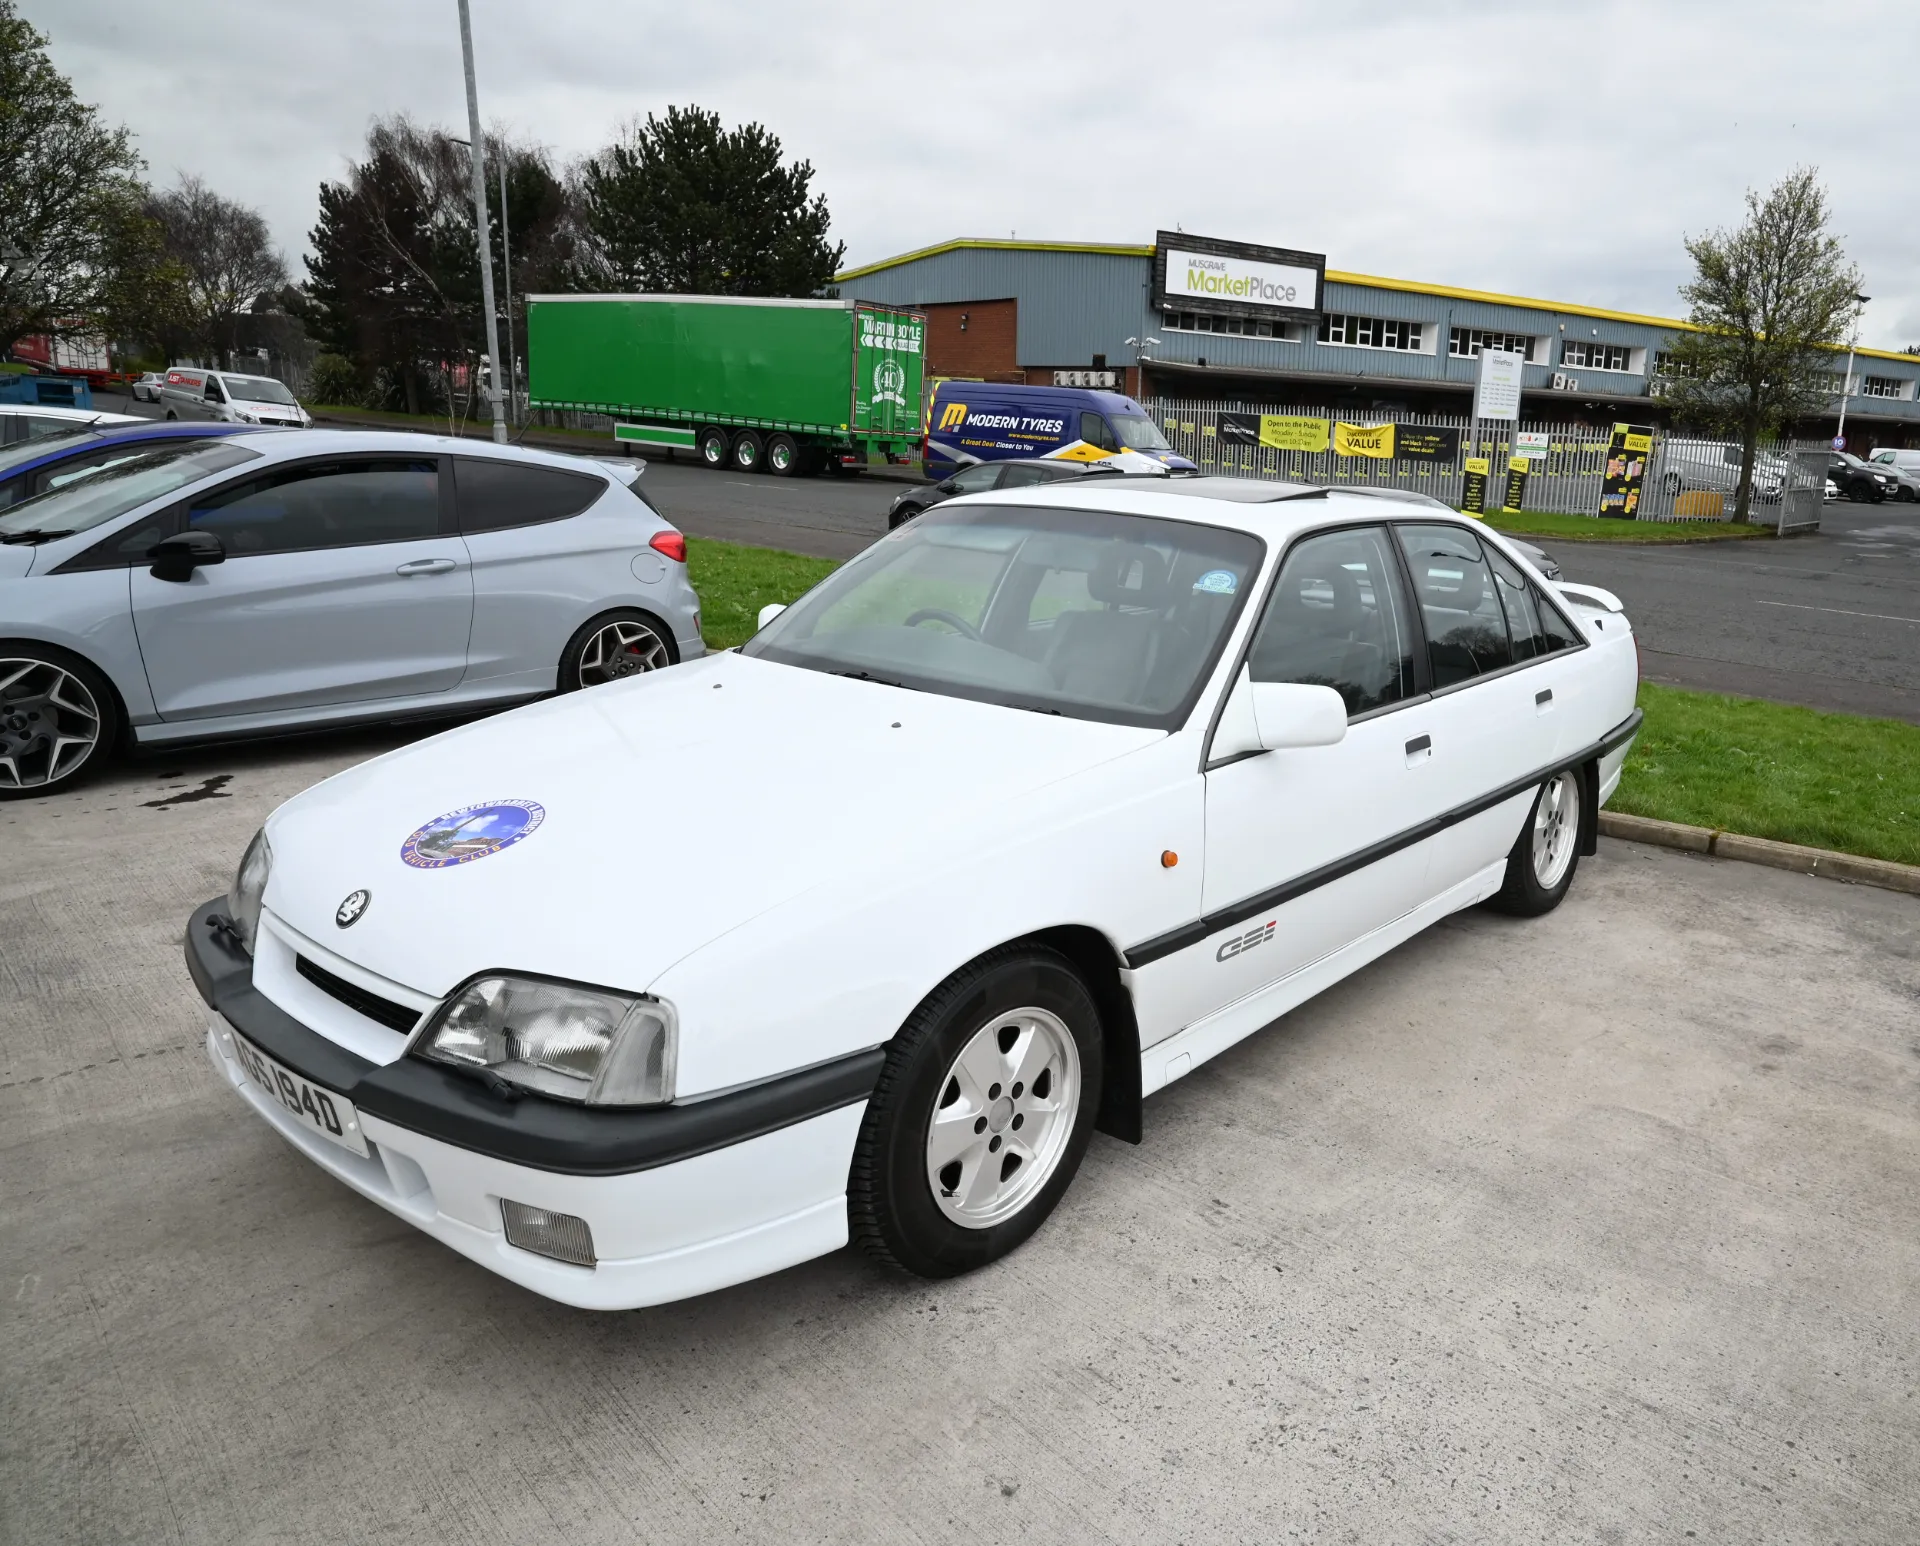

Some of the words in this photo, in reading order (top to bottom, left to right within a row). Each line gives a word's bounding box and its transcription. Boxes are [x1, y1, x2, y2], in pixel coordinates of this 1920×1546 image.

[1188, 258, 1226, 271] MUSGRAVE
[1187, 269, 1297, 302] MarketPlace
[863, 320, 895, 337] MARTIN
[966, 413, 1019, 429] MODERN
[1021, 417, 1063, 433] TYRES
[1267, 419, 1284, 428] Open
[1303, 421, 1321, 431] Public
[1271, 429, 1294, 437] Monday
[965, 439, 981, 447] Great
[1346, 437, 1382, 449] VALUE
[1628, 440, 1648, 449] VALUE
[1834, 438, 1844, 446] 10
[404, 830, 425, 848] OLD
[403, 849, 448, 868] VEHICLE
[458, 845, 502, 864] CLUB
